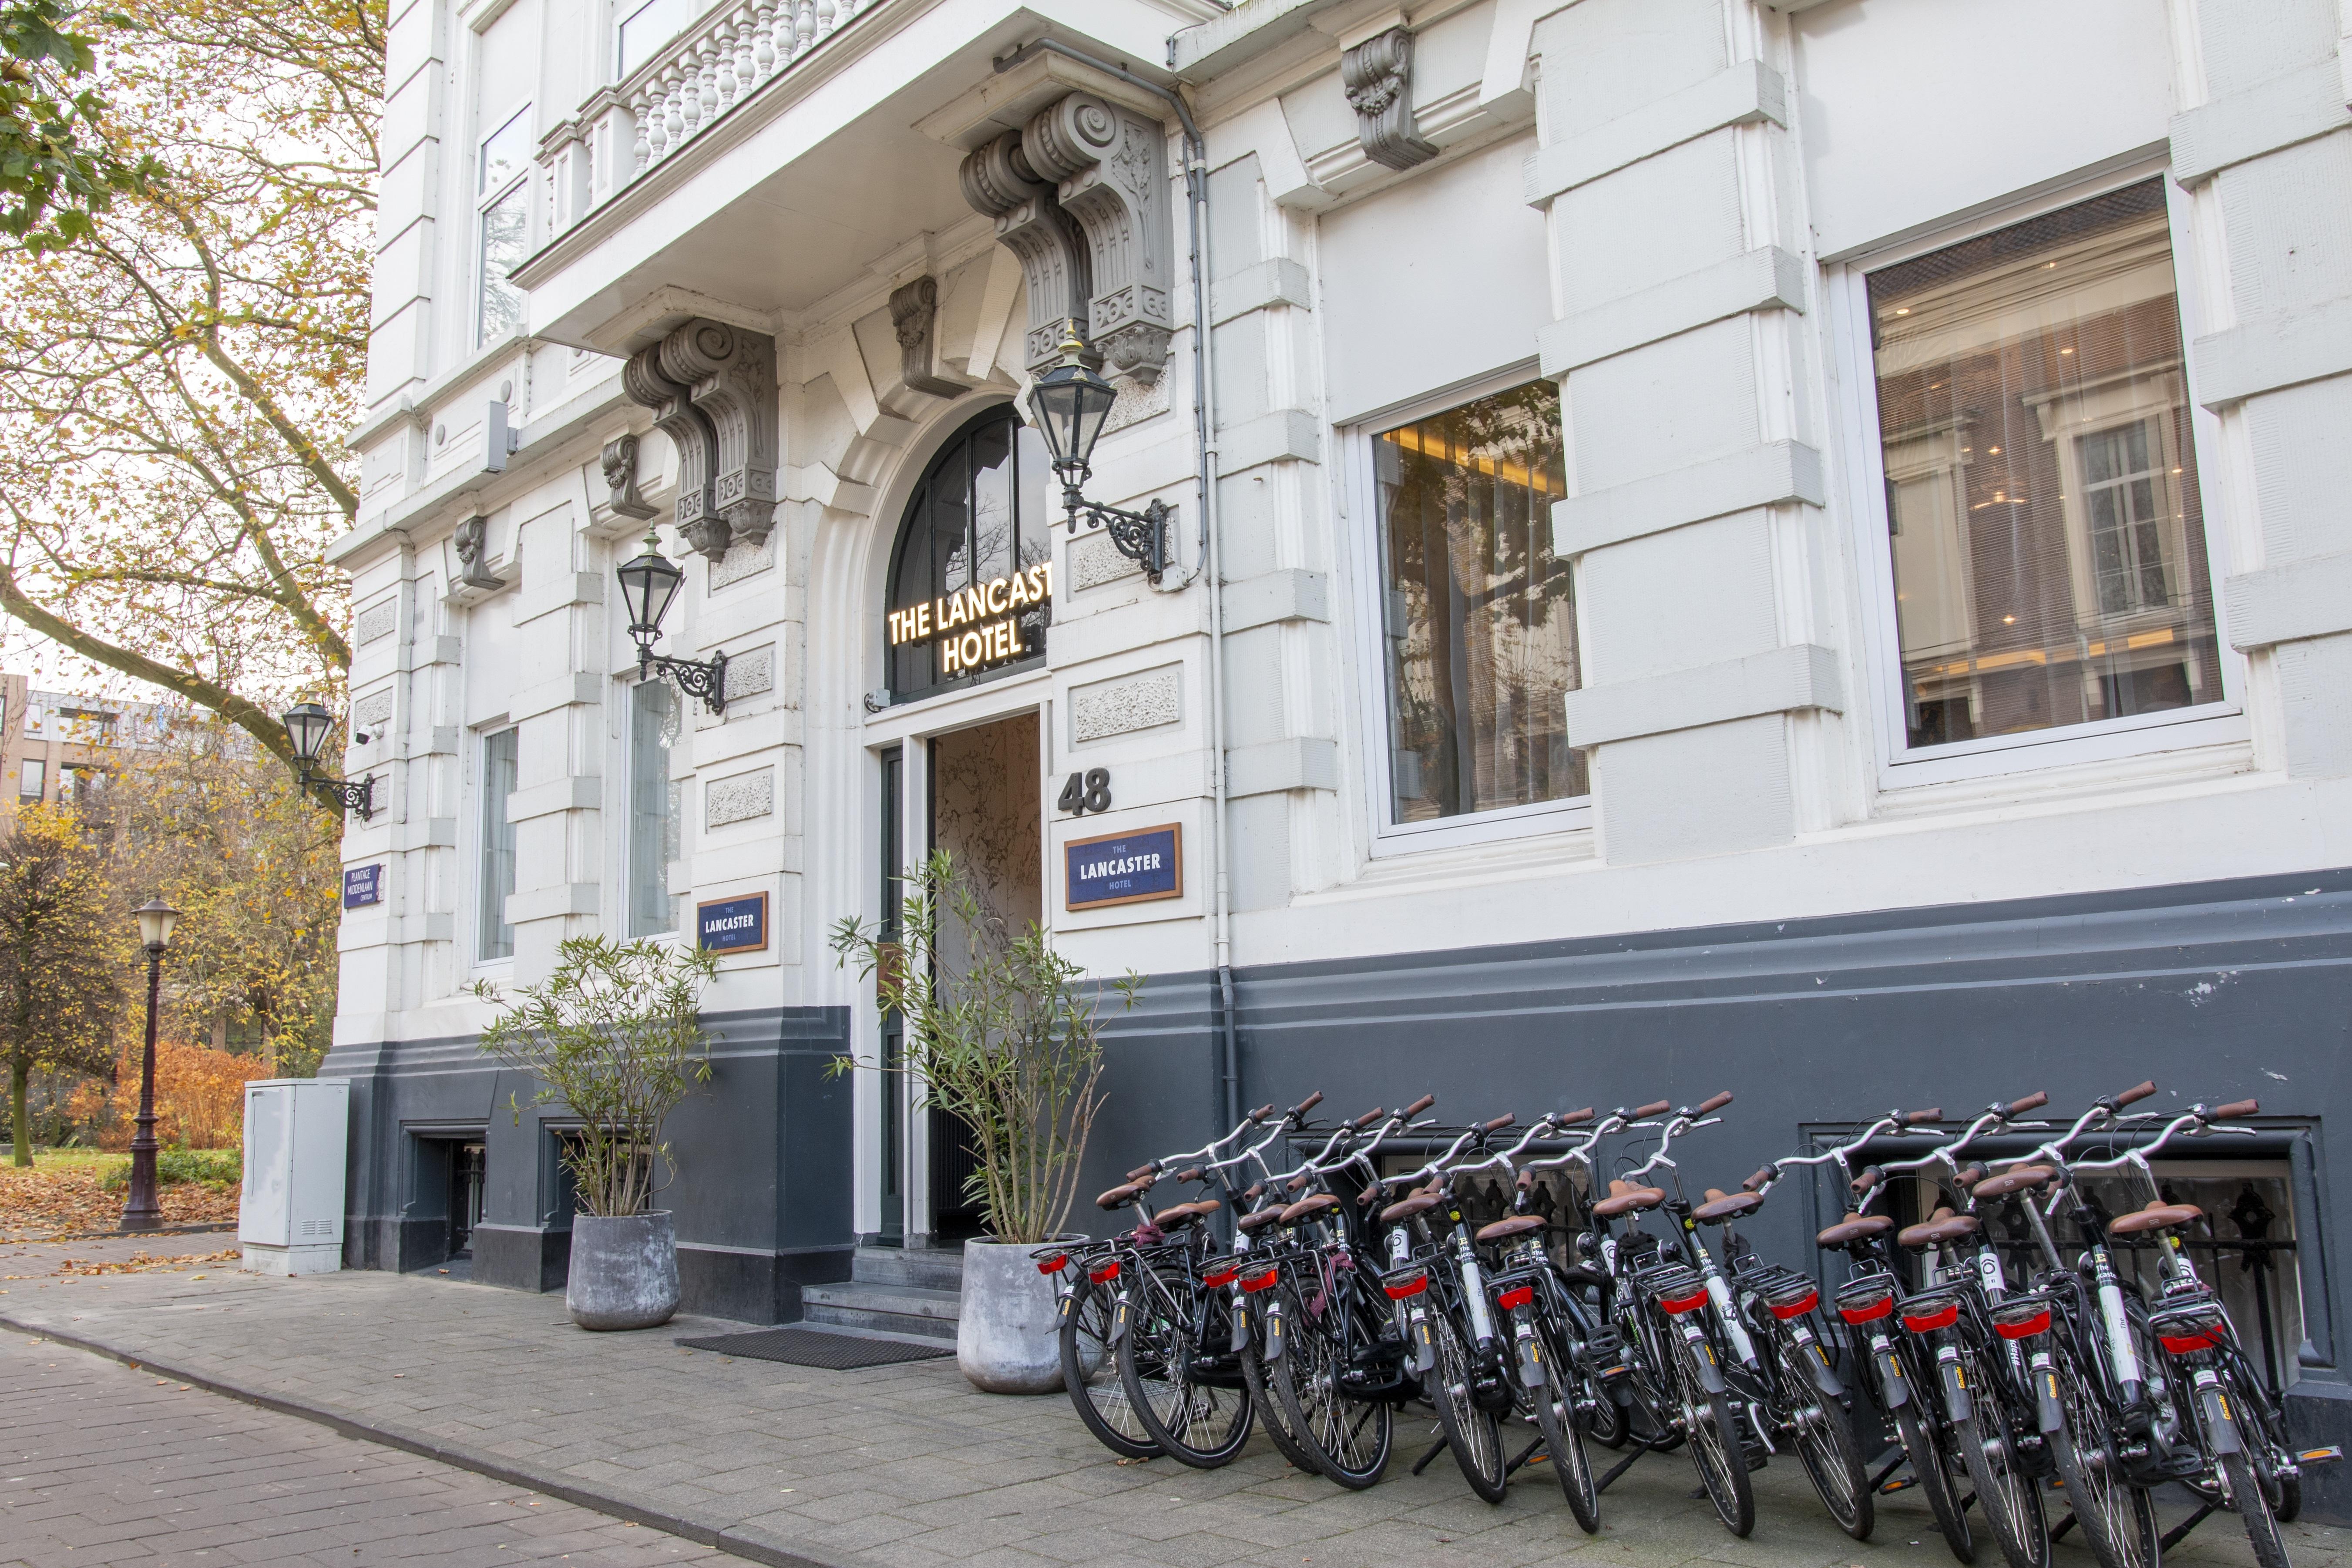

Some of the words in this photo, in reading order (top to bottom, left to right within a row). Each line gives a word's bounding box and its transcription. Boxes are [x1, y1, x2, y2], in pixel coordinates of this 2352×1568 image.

[889, 602, 931, 645] THE
[943, 619, 1021, 673] HOTEL
[1058, 767, 1112, 816] 48
[1112, 844, 1126, 854] THE
[351, 869, 371, 883] PLANTAGE
[1080, 853, 1161, 880] LANCASTER
[347, 880, 373, 896] MIDDENLAAN
[1109, 879, 1132, 890] HOTEL
[360, 893, 373, 901] CENTRUM
[705, 914, 754, 933] LANCASTER
[2009, 1339, 2021, 1366] #Hap
[1890, 1356, 1901, 1377] Gazelle
[1956, 1366, 1966, 1389] Gazelle
[2047, 1374, 2057, 1398] Gazelle
[2219, 1394, 2231, 1420] Gazelle
